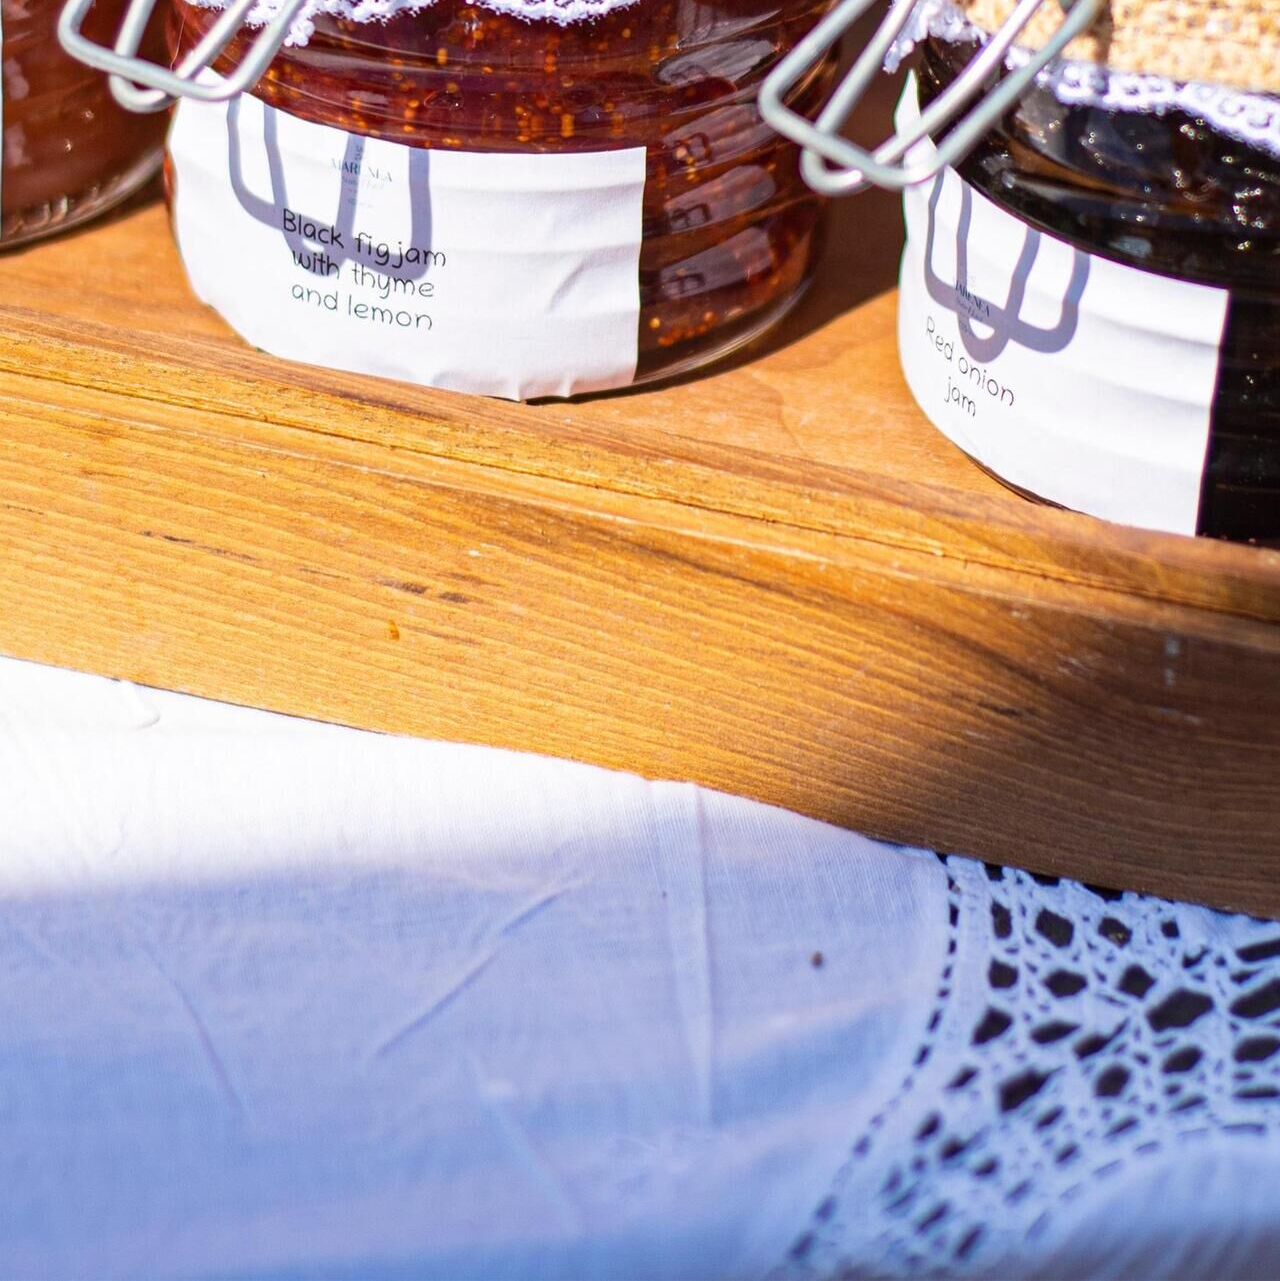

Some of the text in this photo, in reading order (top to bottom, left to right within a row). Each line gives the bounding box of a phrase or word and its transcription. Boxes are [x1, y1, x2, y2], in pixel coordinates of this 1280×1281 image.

[282, 207, 447, 271] Black fig jam
[291, 248, 436, 301] with thyme
[291, 283, 433, 331] and lemon
[925, 315, 1015, 408] Red onion
[944, 376, 977, 418] jam
